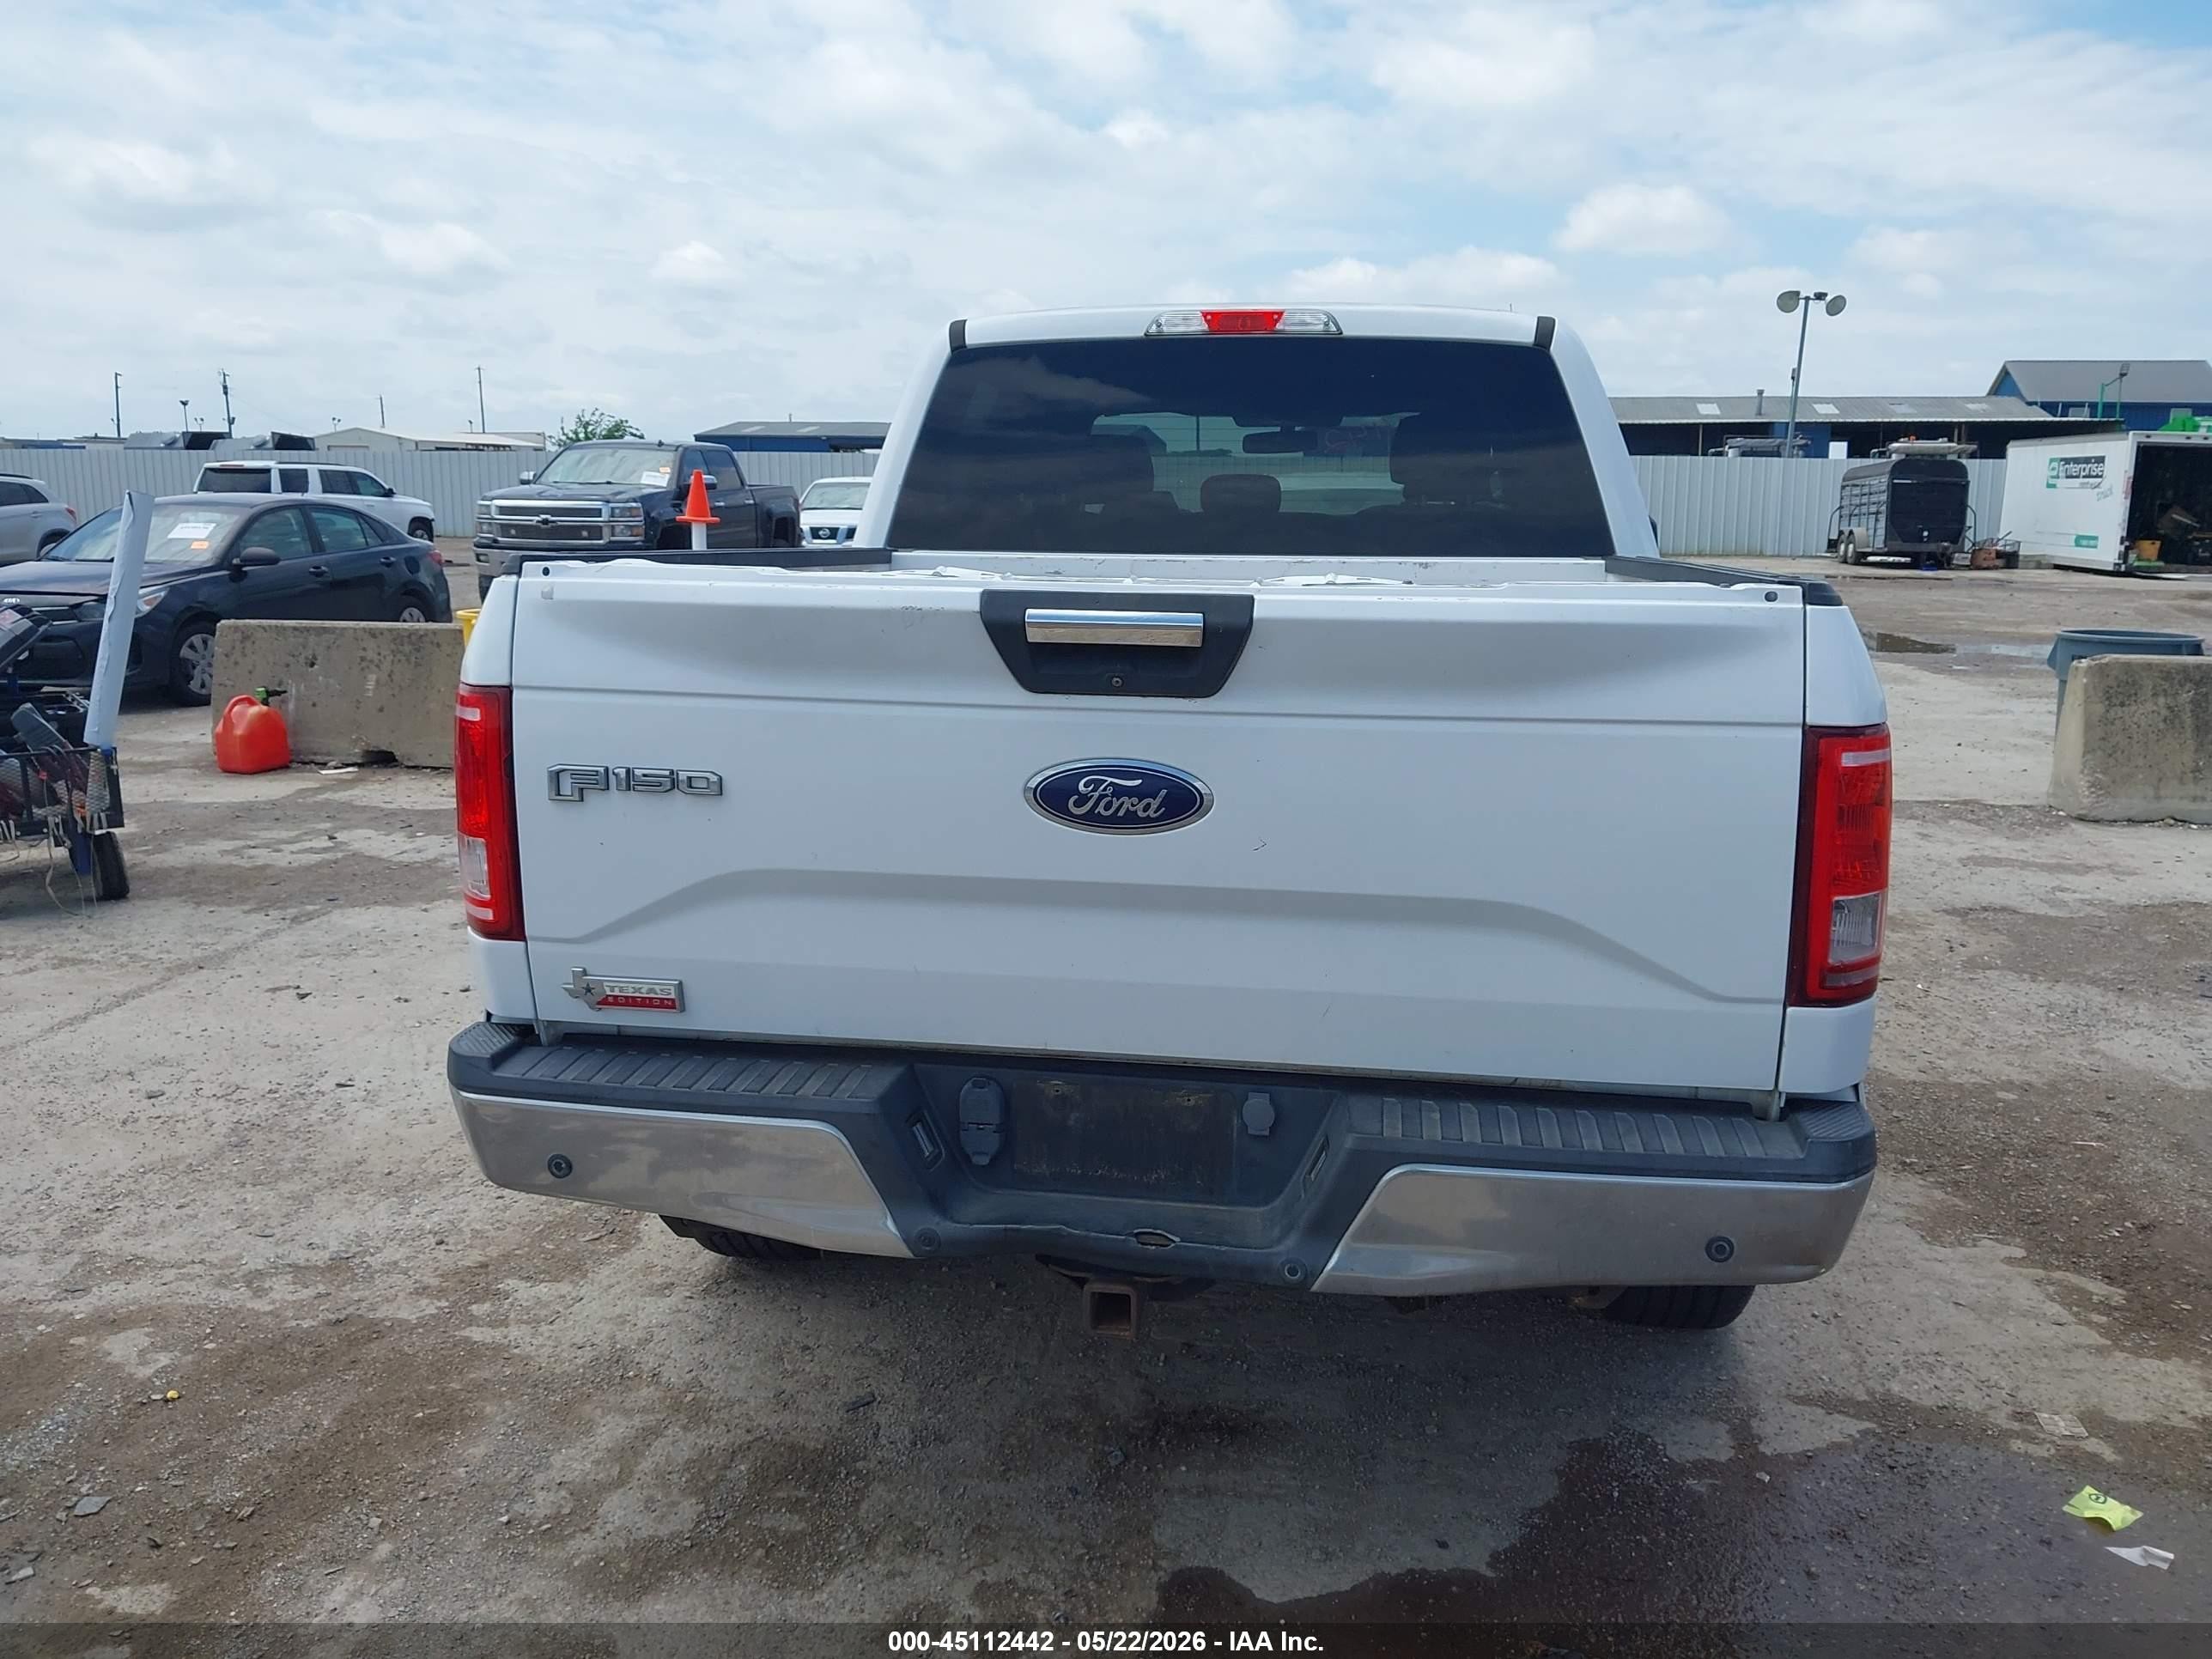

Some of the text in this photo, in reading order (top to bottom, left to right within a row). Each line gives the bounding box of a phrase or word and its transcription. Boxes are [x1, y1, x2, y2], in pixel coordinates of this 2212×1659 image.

[2059, 459, 2104, 478] Enterprise
[1067, 775, 1168, 818] Ford
[605, 984, 672, 996] TEXAS
[606, 996, 673, 1006] EDITION
